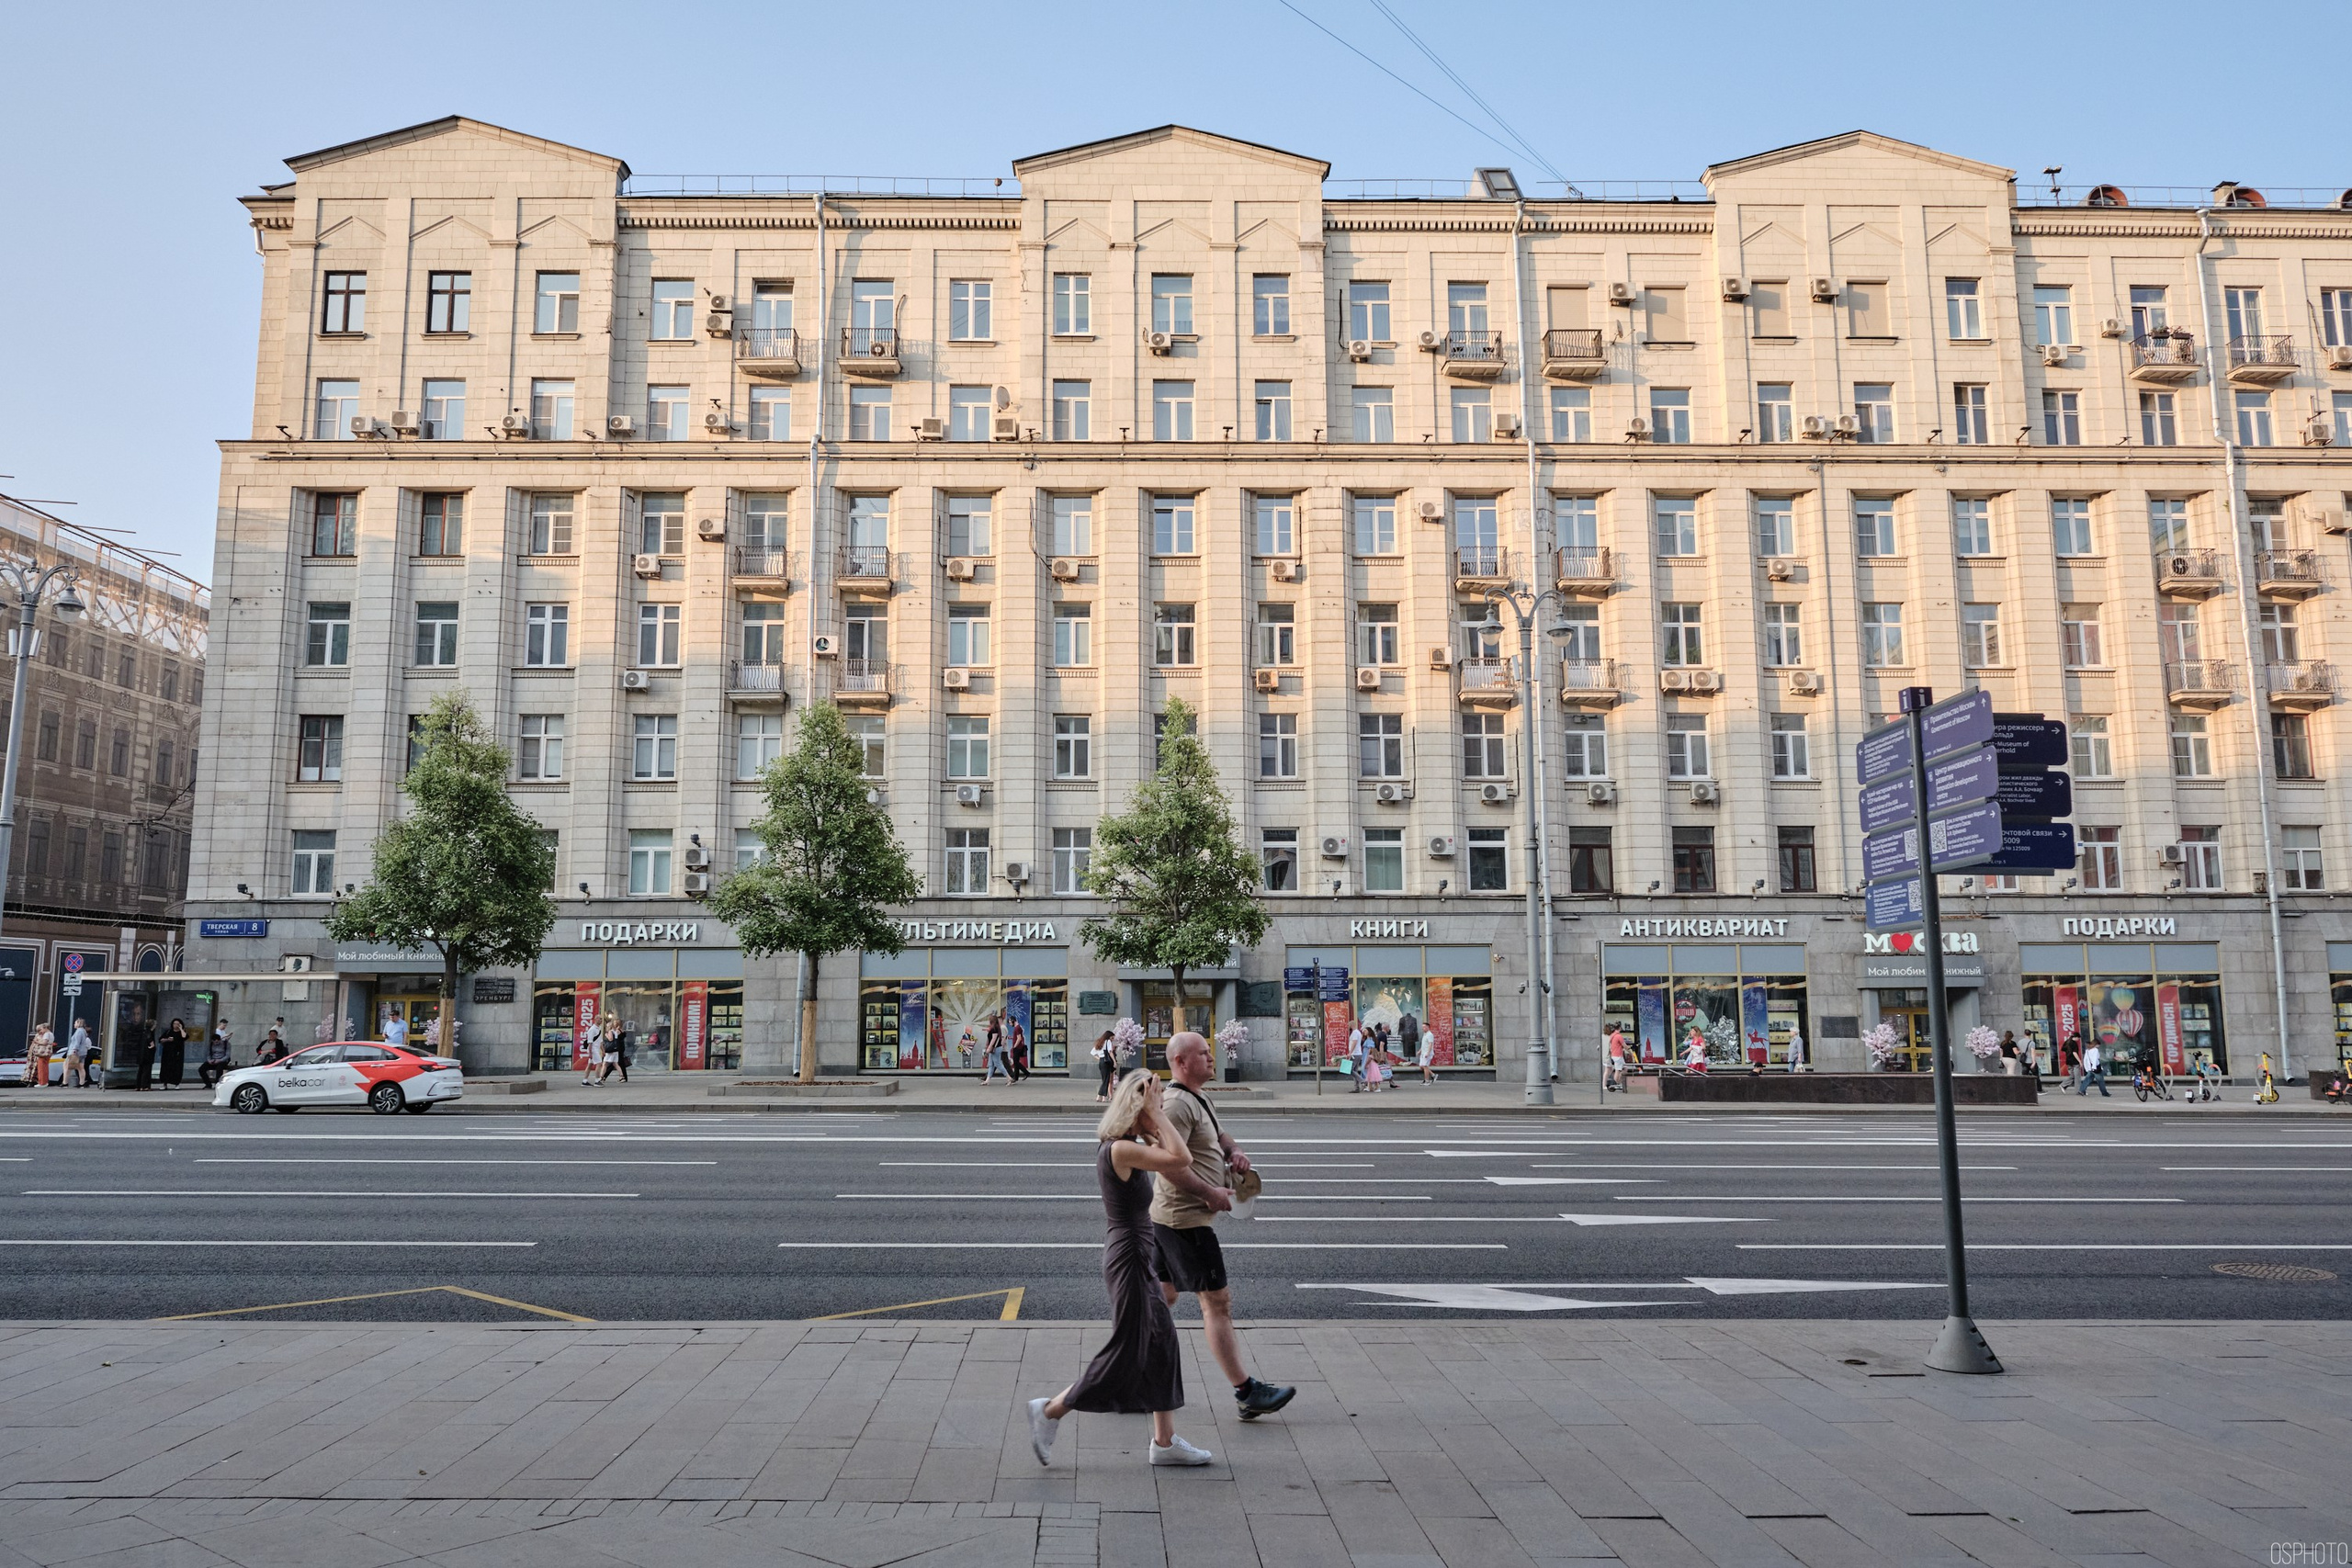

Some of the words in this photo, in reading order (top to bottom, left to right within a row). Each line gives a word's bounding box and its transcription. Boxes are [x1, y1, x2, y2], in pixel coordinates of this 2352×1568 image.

[252, 922, 257, 931] 8
[582, 922, 697, 945] ПОДАРКИ
[1351, 919, 1428, 937] КНИГИ
[1620, 919, 1788, 937] АНТИКВАРИАТ
[2064, 917, 2176, 939] ПОДАРКИ
[338, 952, 356, 961] Мой
[358, 951, 404, 961] любимый
[1868, 966, 1889, 976] Мой
[1891, 966, 1926, 976] любим
[686, 1000, 701, 1058] ПОМНИМ!
[2163, 1003, 2178, 1062] ГОРДИМСЯ!
[278, 1077, 326, 1088] belkacar
